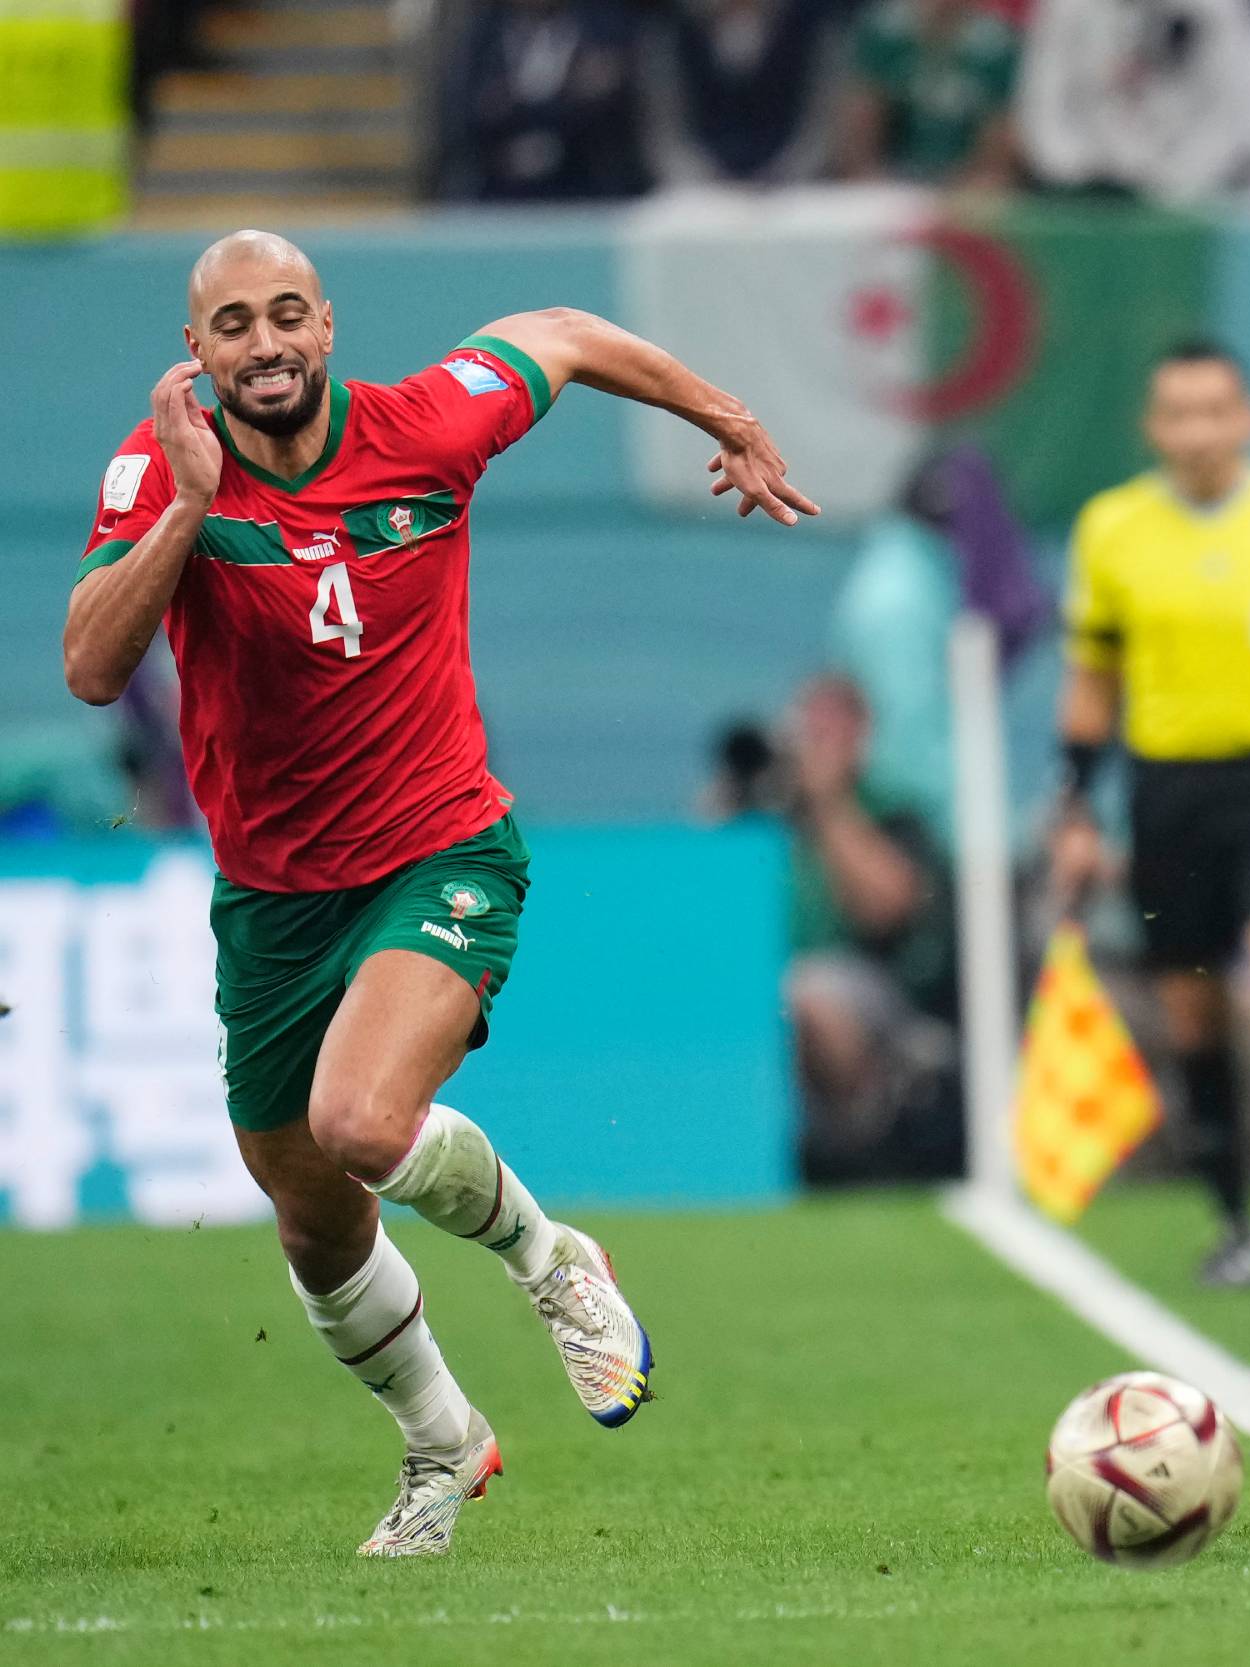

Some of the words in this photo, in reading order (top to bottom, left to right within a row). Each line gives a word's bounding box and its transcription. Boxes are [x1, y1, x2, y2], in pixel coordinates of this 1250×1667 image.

[293, 541, 335, 560] PUMA
[309, 561, 363, 658] 4
[421, 920, 462, 950] PUMA
